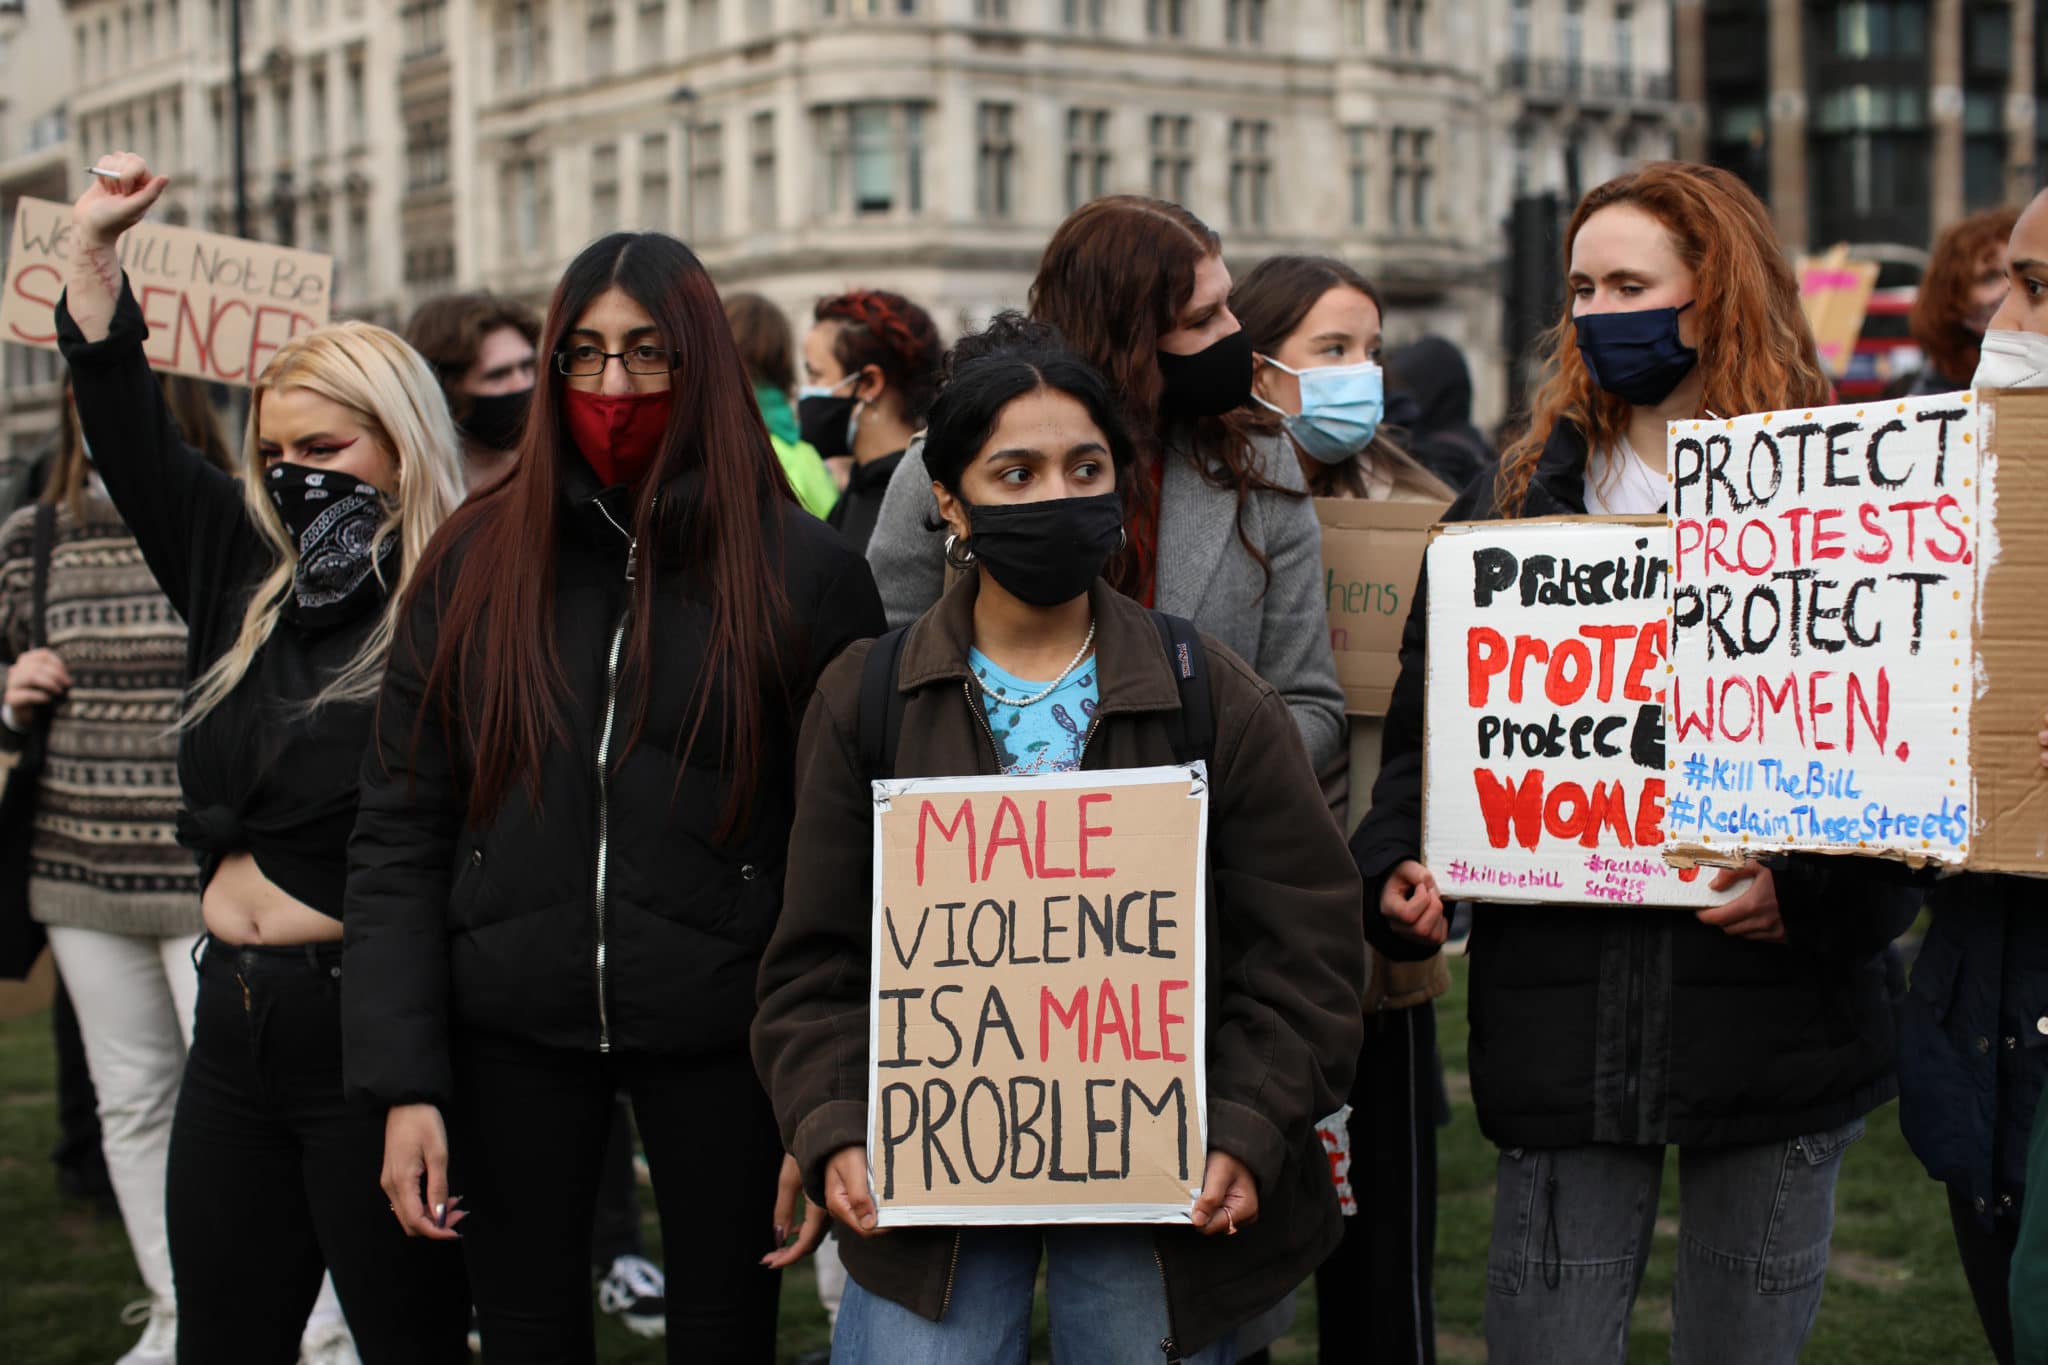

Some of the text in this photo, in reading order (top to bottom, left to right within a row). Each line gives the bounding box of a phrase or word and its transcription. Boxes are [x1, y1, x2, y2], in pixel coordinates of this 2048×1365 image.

[20, 208, 324, 305] We ILL Not Be
[10, 264, 319, 385] SENCE
[1674, 408, 1968, 515] PROTECT
[1674, 494, 1972, 582] PROTESTS.
[1671, 568, 1949, 661] PROTECT
[1674, 665, 1910, 763] WOMEN.
[915, 792, 1116, 887] MALE
[1473, 766, 1666, 854] WOME
[885, 890, 1177, 970] VIOLENCE
[1605, 873, 1647, 893] these
[1039, 977, 1190, 1063] MALE
[882, 1076, 1189, 1200] PROBLEM
